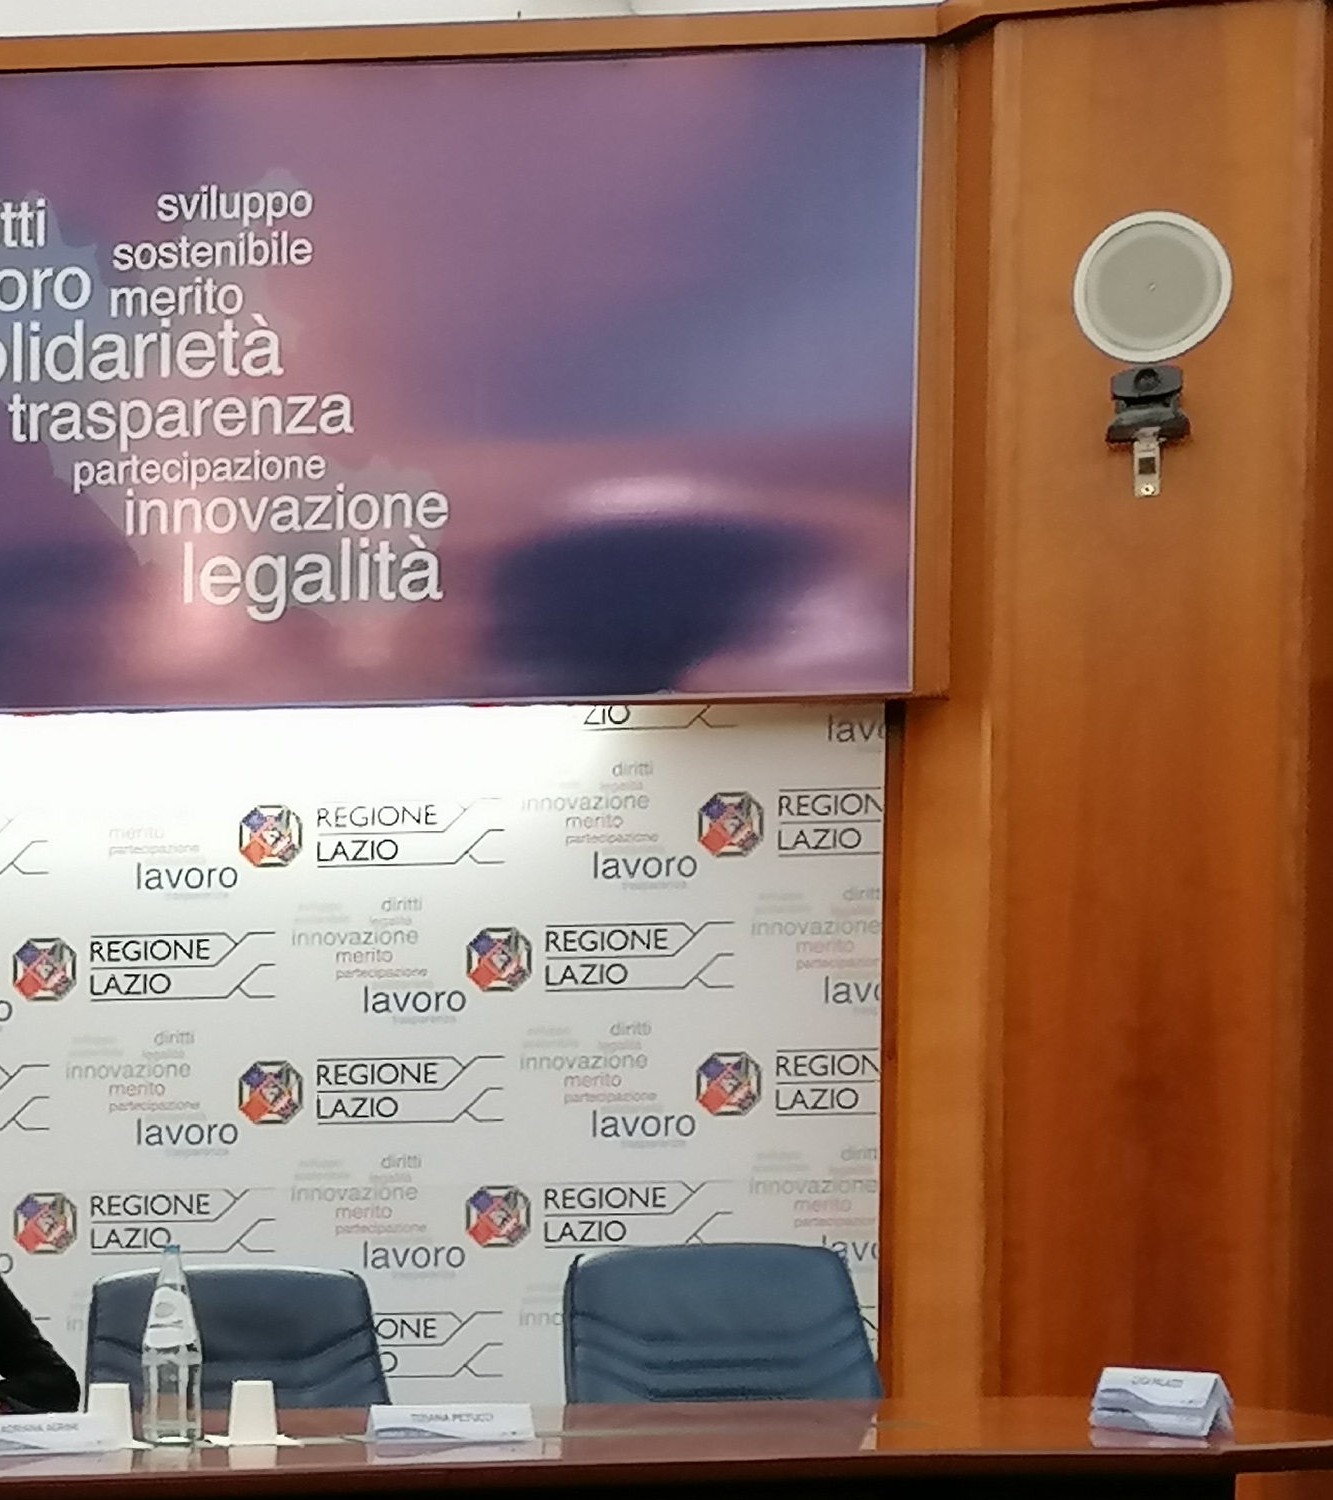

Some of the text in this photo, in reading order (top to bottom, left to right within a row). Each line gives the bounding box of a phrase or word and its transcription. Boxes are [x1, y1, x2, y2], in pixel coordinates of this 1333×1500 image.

[156, 184, 313, 227] sviluppo
[112, 230, 313, 270] sostenibile
[110, 277, 244, 318] merito
[8, 392, 354, 452] trasparenza
[73, 451, 326, 493] partecipazione
[125, 482, 449, 538] innovazione
[183, 535, 443, 622] legalità
[522, 793, 650, 811] innovazione
[317, 805, 439, 828] REGIONE
[317, 839, 399, 862] LAZIO
[778, 828, 861, 851] LAZIO
[136, 862, 238, 890] lavoro
[593, 851, 698, 880] lavoro
[291, 928, 418, 945] innovazione
[751, 918, 881, 936] innovazione
[90, 939, 211, 962] REGIONE
[545, 929, 668, 952] REGIONE
[90, 973, 171, 996] LAZIO
[545, 963, 629, 986] LAZIO
[363, 985, 467, 1014] lavoro
[65, 1060, 191, 1079] innovazione
[520, 1053, 648, 1071] innovazione
[316, 1062, 438, 1086] REGIONE
[316, 1096, 399, 1118] LAZIO
[775, 1088, 859, 1111] LAZIO
[136, 1117, 239, 1146] lavoro
[591, 1109, 696, 1138] lavoro
[90, 1194, 211, 1217] REGIONE
[290, 1185, 418, 1203] innovazione
[544, 1187, 667, 1210] REGIONE
[90, 1227, 171, 1249] LAZIO
[544, 1220, 626, 1243] LAZIO
[362, 1240, 466, 1270] lavoro
